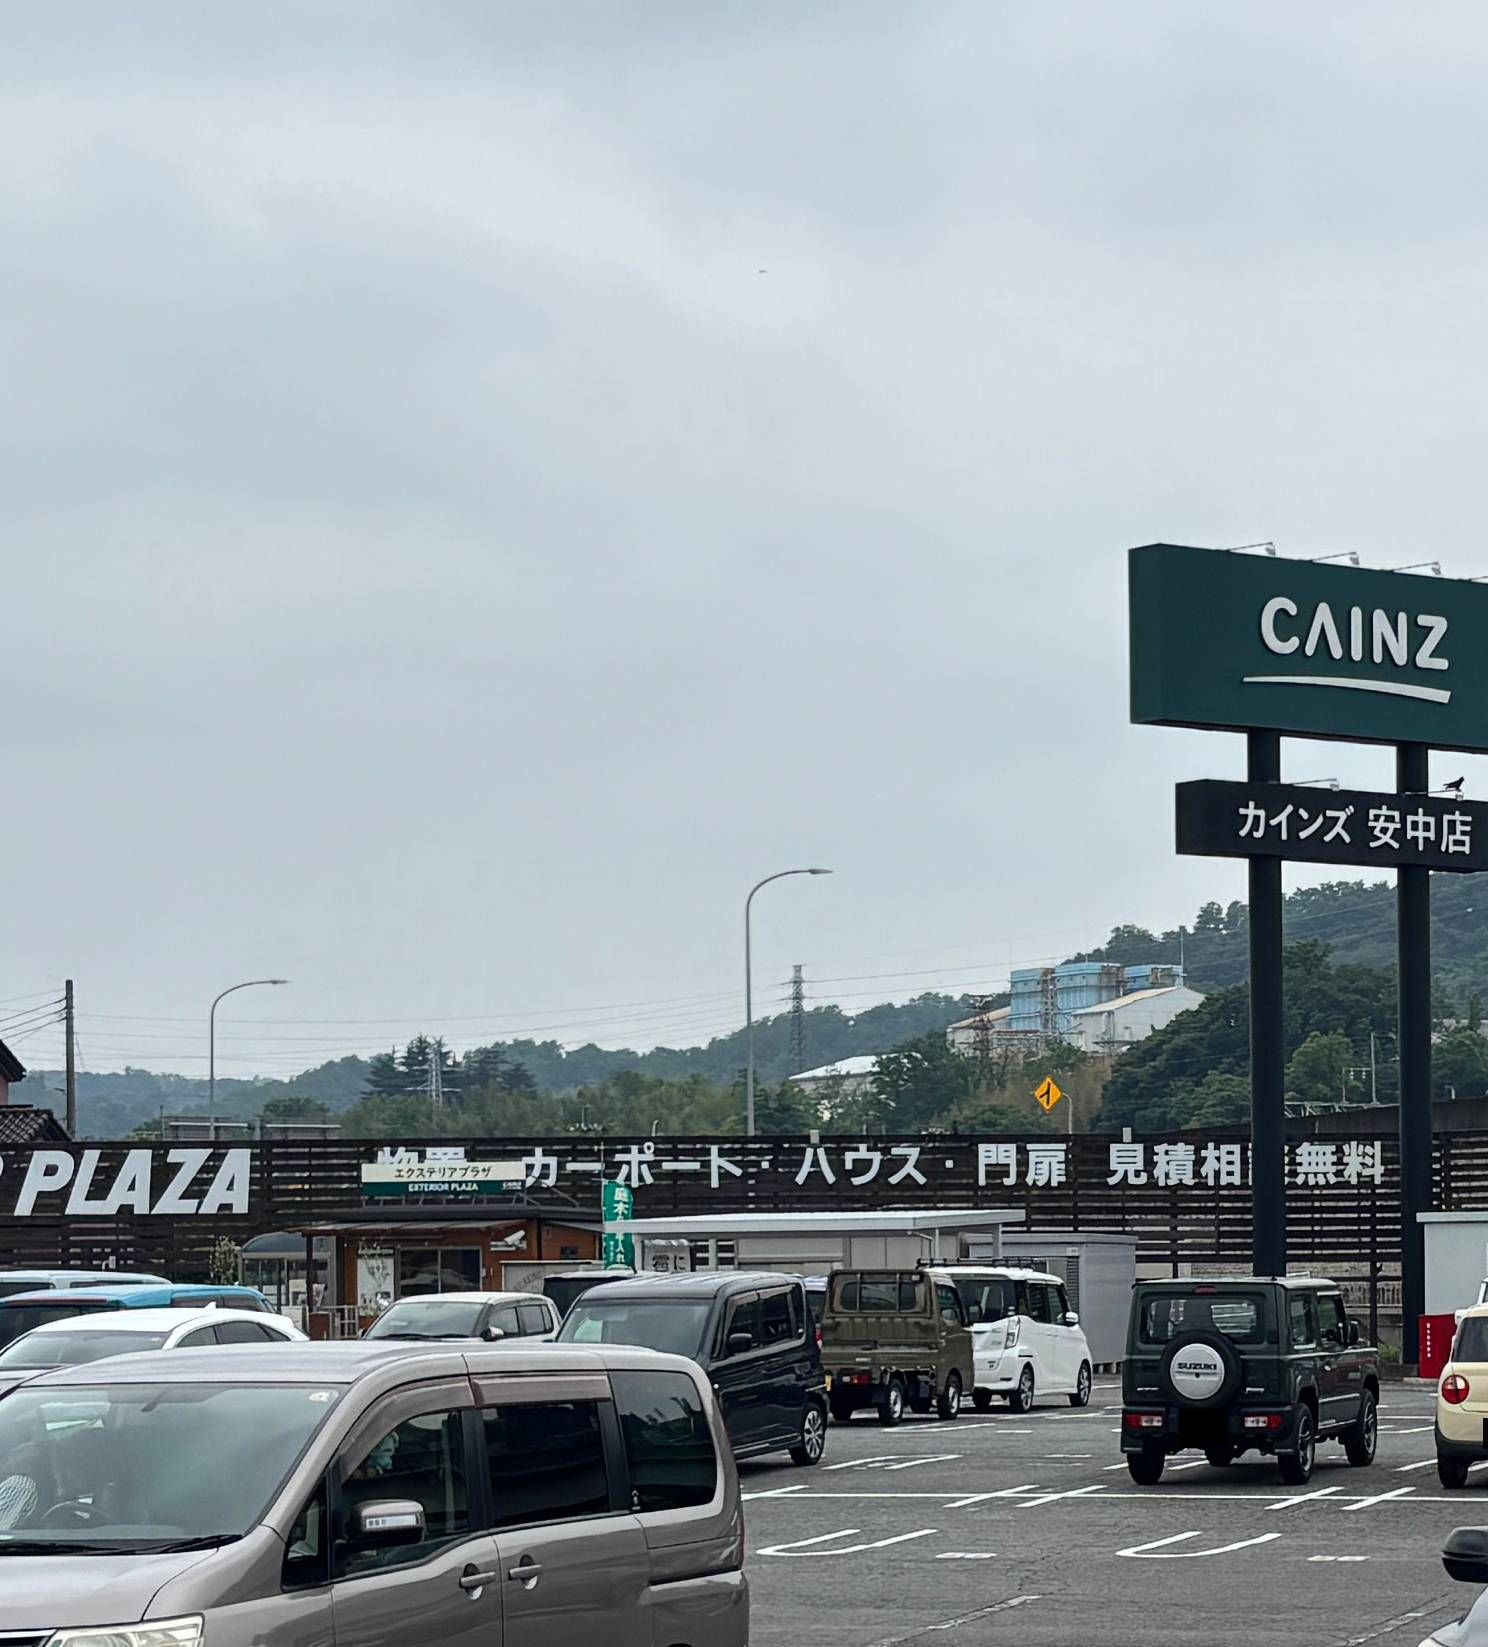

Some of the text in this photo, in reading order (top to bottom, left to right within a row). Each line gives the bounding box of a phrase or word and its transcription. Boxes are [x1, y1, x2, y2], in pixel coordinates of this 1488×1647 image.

[1261, 596, 1449, 671] CAINZ
[1238, 801, 1473, 854] カインズ 安中店
[14, 1149, 250, 1216] PLAZA
[395, 1166, 492, 1179] エクステリアプラザ
[408, 1183, 479, 1193] EXTERIOR PLAZA
[1177, 1362, 1217, 1371] SUZUKI
